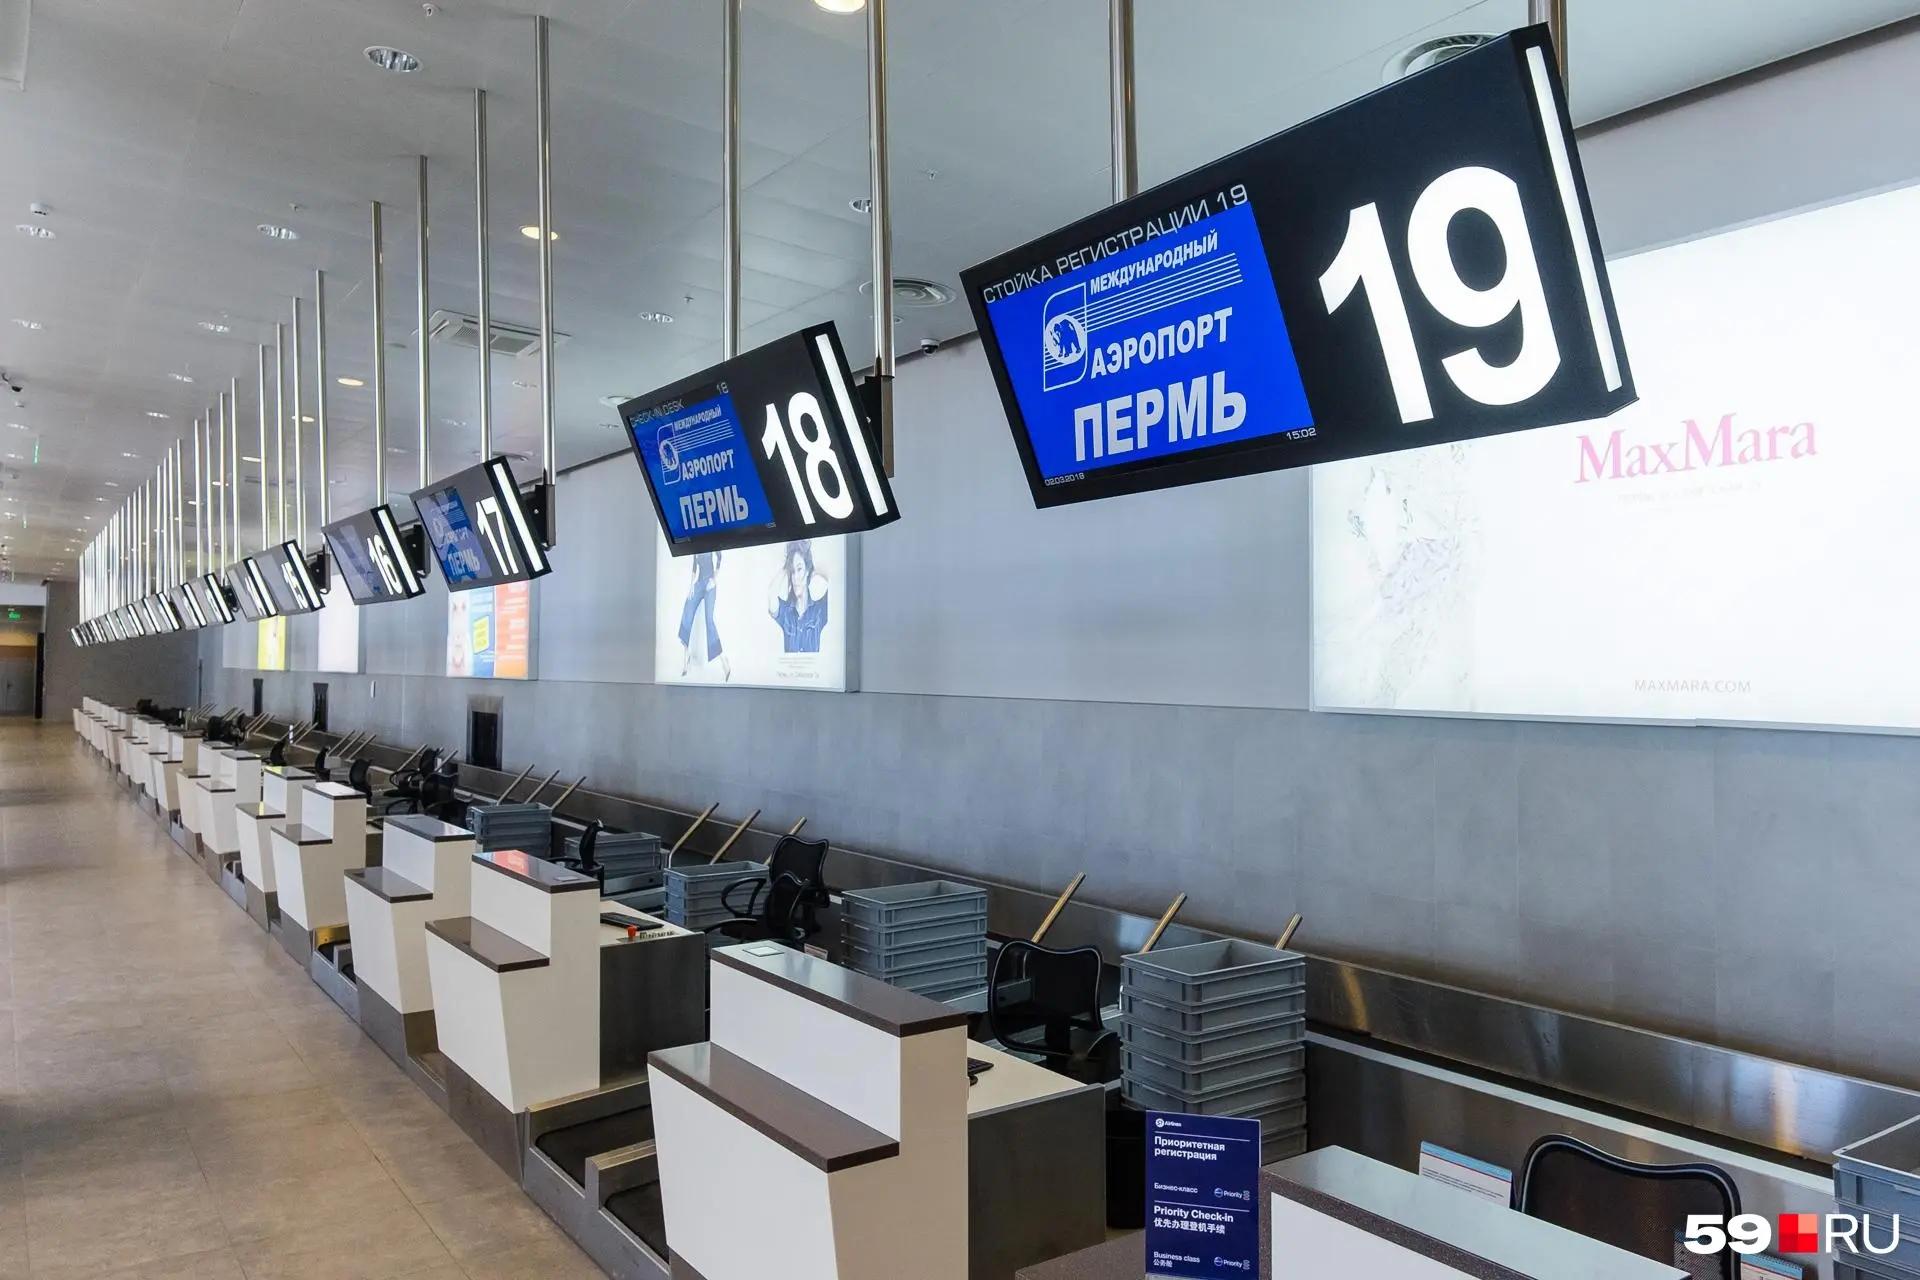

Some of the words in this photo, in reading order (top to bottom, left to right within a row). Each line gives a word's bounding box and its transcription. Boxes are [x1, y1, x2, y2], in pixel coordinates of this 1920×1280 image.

[983, 265, 1053, 304] СТОЙКА
[1056, 199, 1210, 276] РЕГИСТРАЦИИ
[1217, 184, 1248, 211] 19
[1090, 229, 1218, 296] МЕЖДУНАРОДНЫЙ
[1318, 166, 1562, 424] 19
[1091, 305, 1234, 379] АЭРОПОРТ
[662, 399, 685, 417] DESK
[716, 381, 729, 395] 18
[674, 404, 722, 431] МЕЖДУНАРОДНЫЙ
[1073, 370, 1247, 462] ПЕРМЬ
[682, 449, 734, 480] АЭРОПОРТ
[761, 391, 854, 525] 18
[1573, 412, 1819, 484] MaxMara
[679, 484, 749, 530] ПЕРМЬ
[475, 496, 519, 576] 17
[367, 535, 403, 596] 16
[448, 549, 481, 576] ПЕРМЬ
[1634, 678, 1752, 695] MAXMARA.COM
[1154, 1136, 1225, 1151] Приоритетная
[1154, 1148, 1217, 1161] регистрация
[1154, 1183, 1198, 1193] Бизнес-класс
[1223, 1190, 1242, 1199] Priority
[1154, 1205, 1189, 1219] Priority
[1191, 1209, 1234, 1222] Check-in
[1153, 1251, 1182, 1261] Business
[1184, 1255, 1200, 1263] class
[1223, 1259, 1242, 1268] Priority
